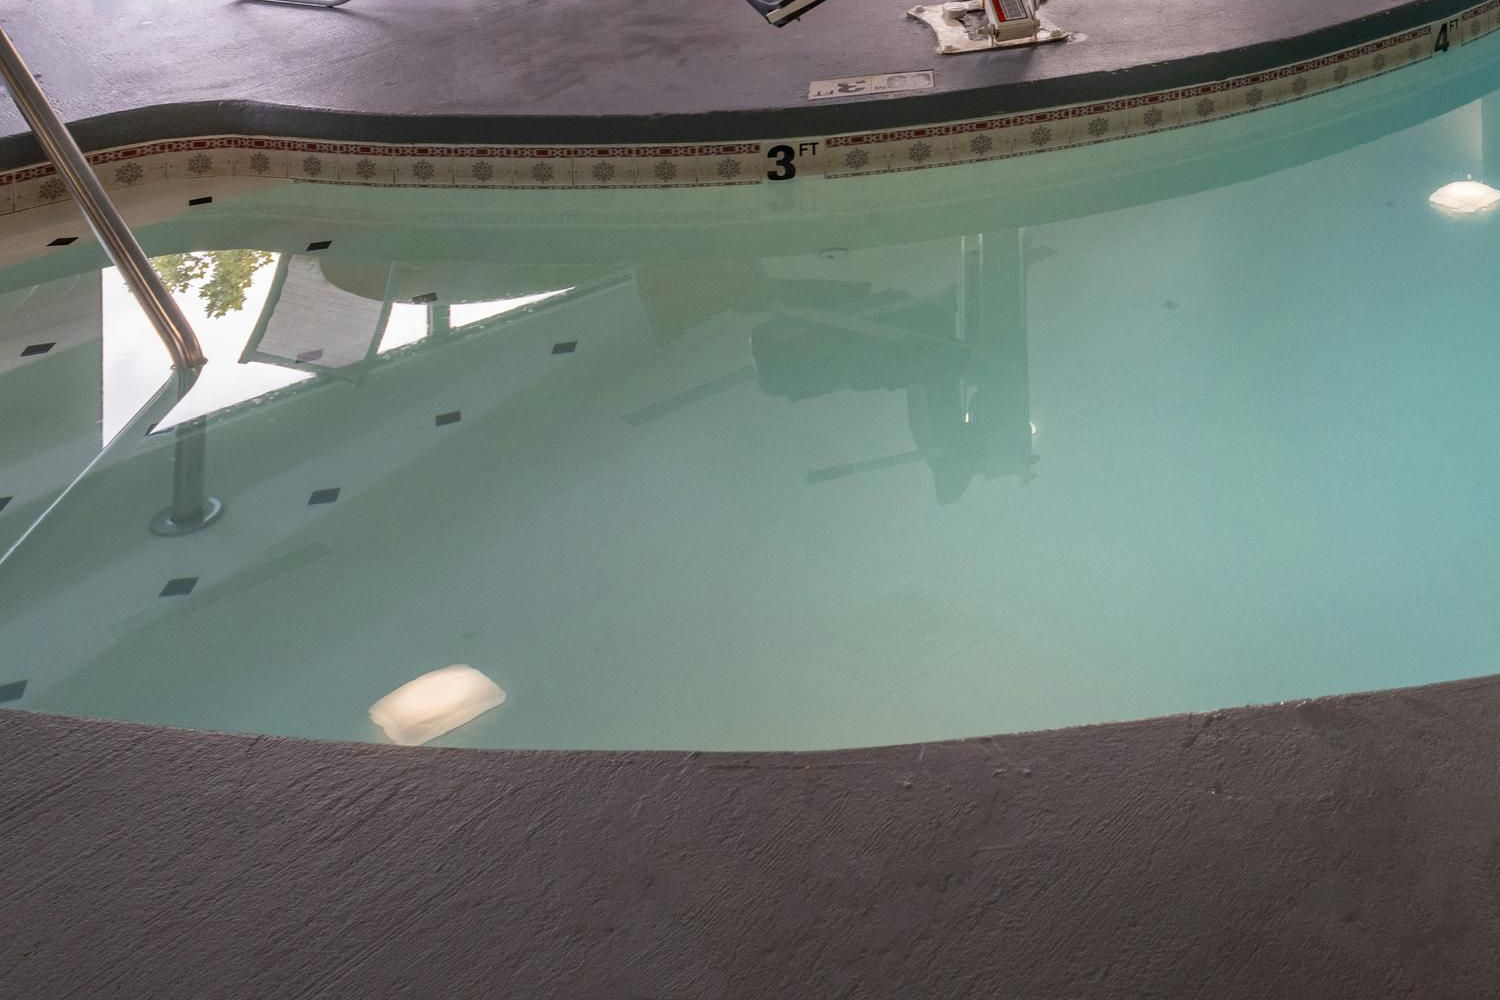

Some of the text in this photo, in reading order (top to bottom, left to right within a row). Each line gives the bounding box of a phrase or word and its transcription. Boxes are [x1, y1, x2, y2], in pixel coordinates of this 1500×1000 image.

[1434, 19, 1459, 52] 4 FT
[767, 142, 819, 180] 3 FT
